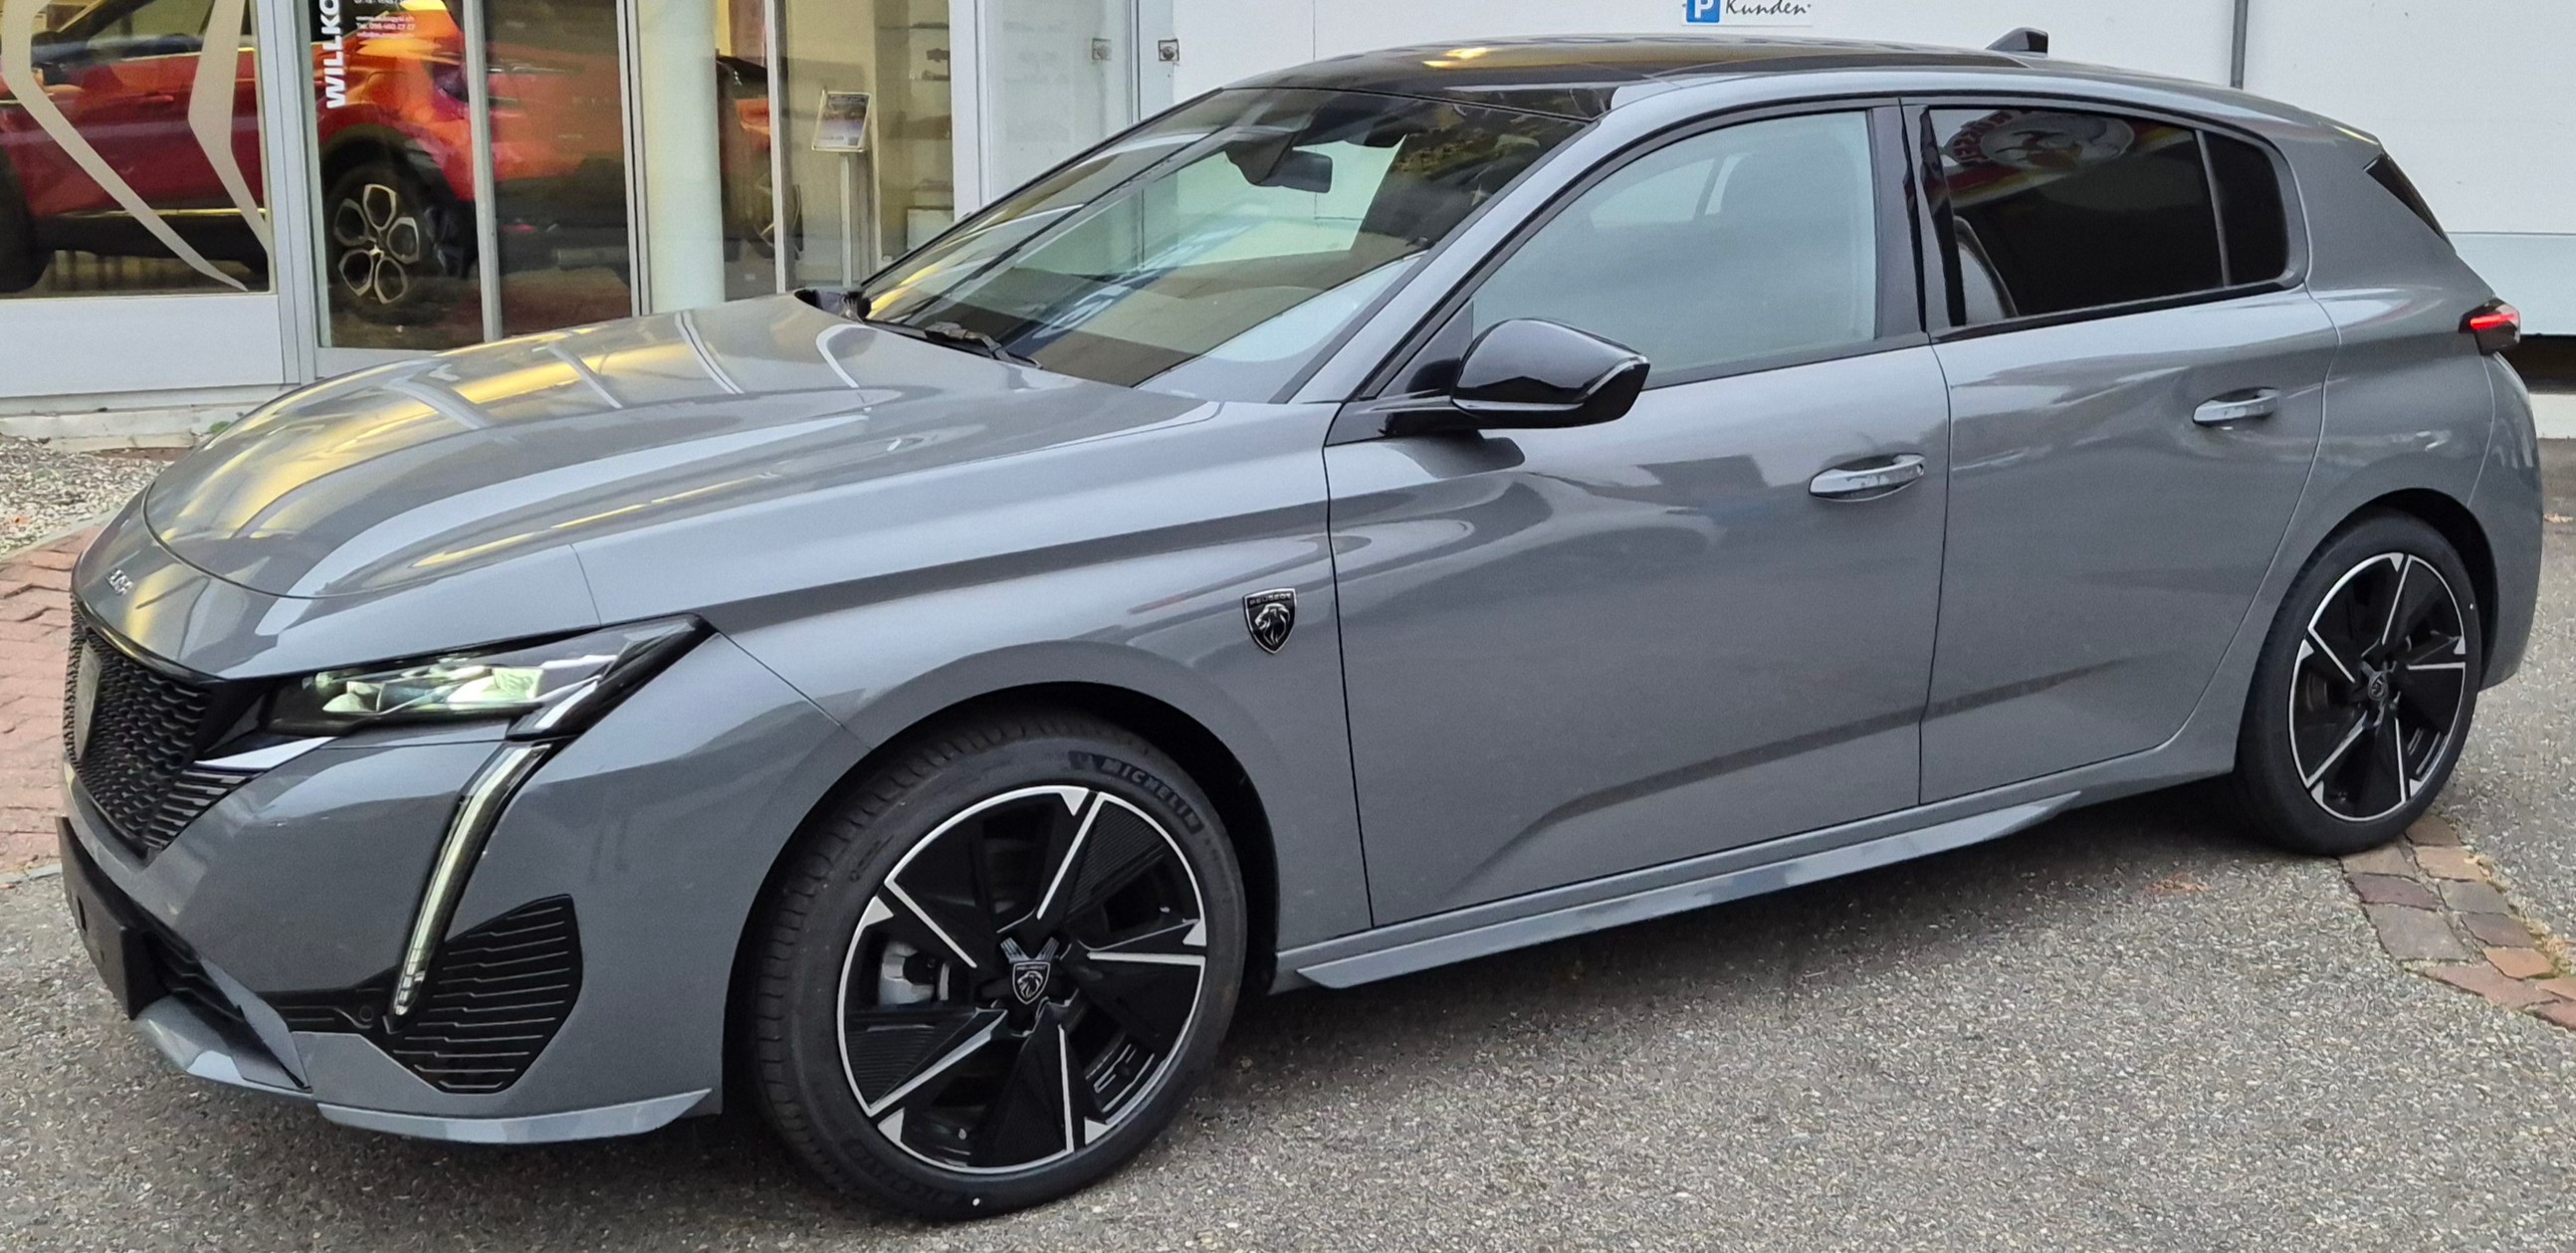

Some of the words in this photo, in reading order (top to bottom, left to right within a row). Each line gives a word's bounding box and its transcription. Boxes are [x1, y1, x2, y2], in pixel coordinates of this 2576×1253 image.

[1694, 0, 1714, 18] P
[1725, 0, 1808, 15] Kunden
[1100, 757, 1202, 832] MICHELIN
